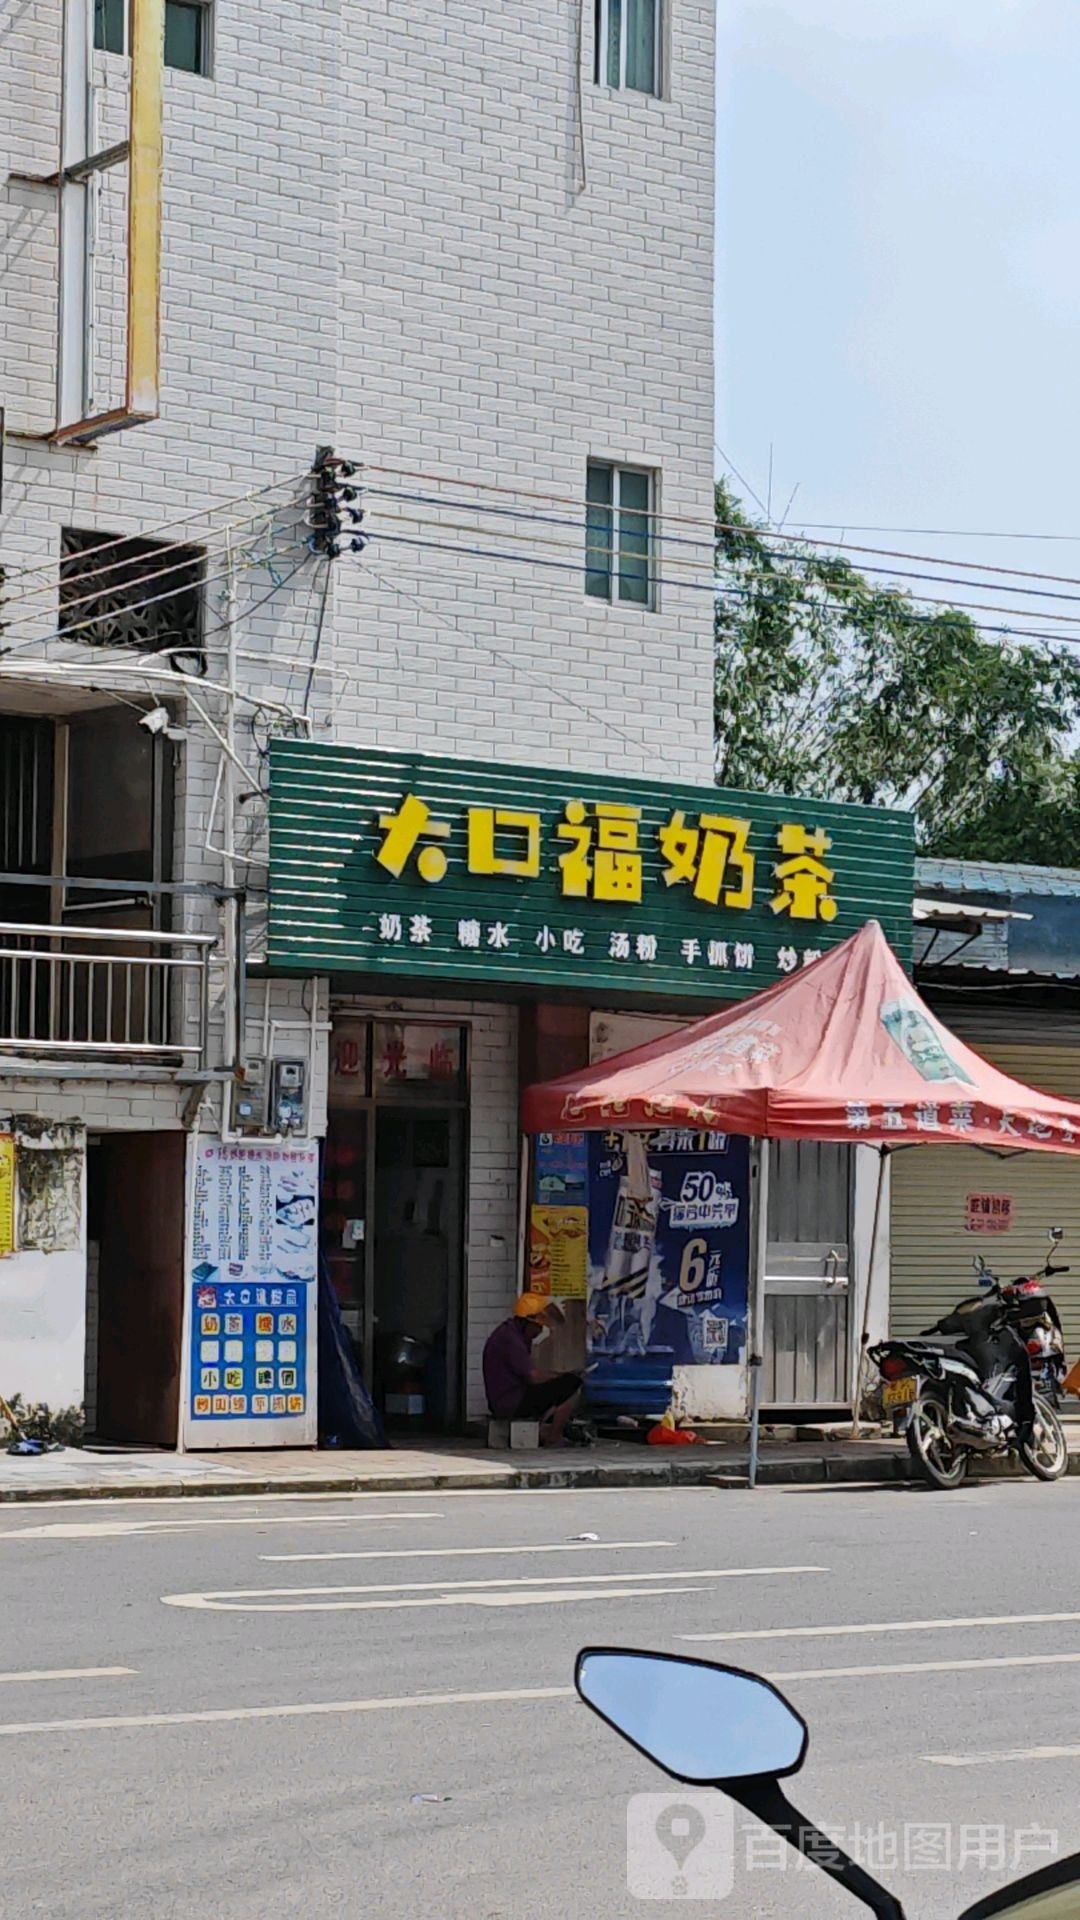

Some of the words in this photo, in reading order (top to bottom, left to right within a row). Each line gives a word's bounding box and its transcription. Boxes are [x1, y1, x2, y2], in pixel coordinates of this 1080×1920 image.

[376, 793, 839, 922] 大口福奶茶
[378, 912, 432, 943] 奶茶
[457, 918, 510, 948] 糖水
[535, 924, 585, 954] 小吃
[608, 930, 657, 960] 汤粉
[681, 937, 754, 969] 手抓饼
[682, 1173, 733, 1202] 50%
[679, 1238, 707, 1292] 6
[203, 1370, 241, 1388] 小吃
